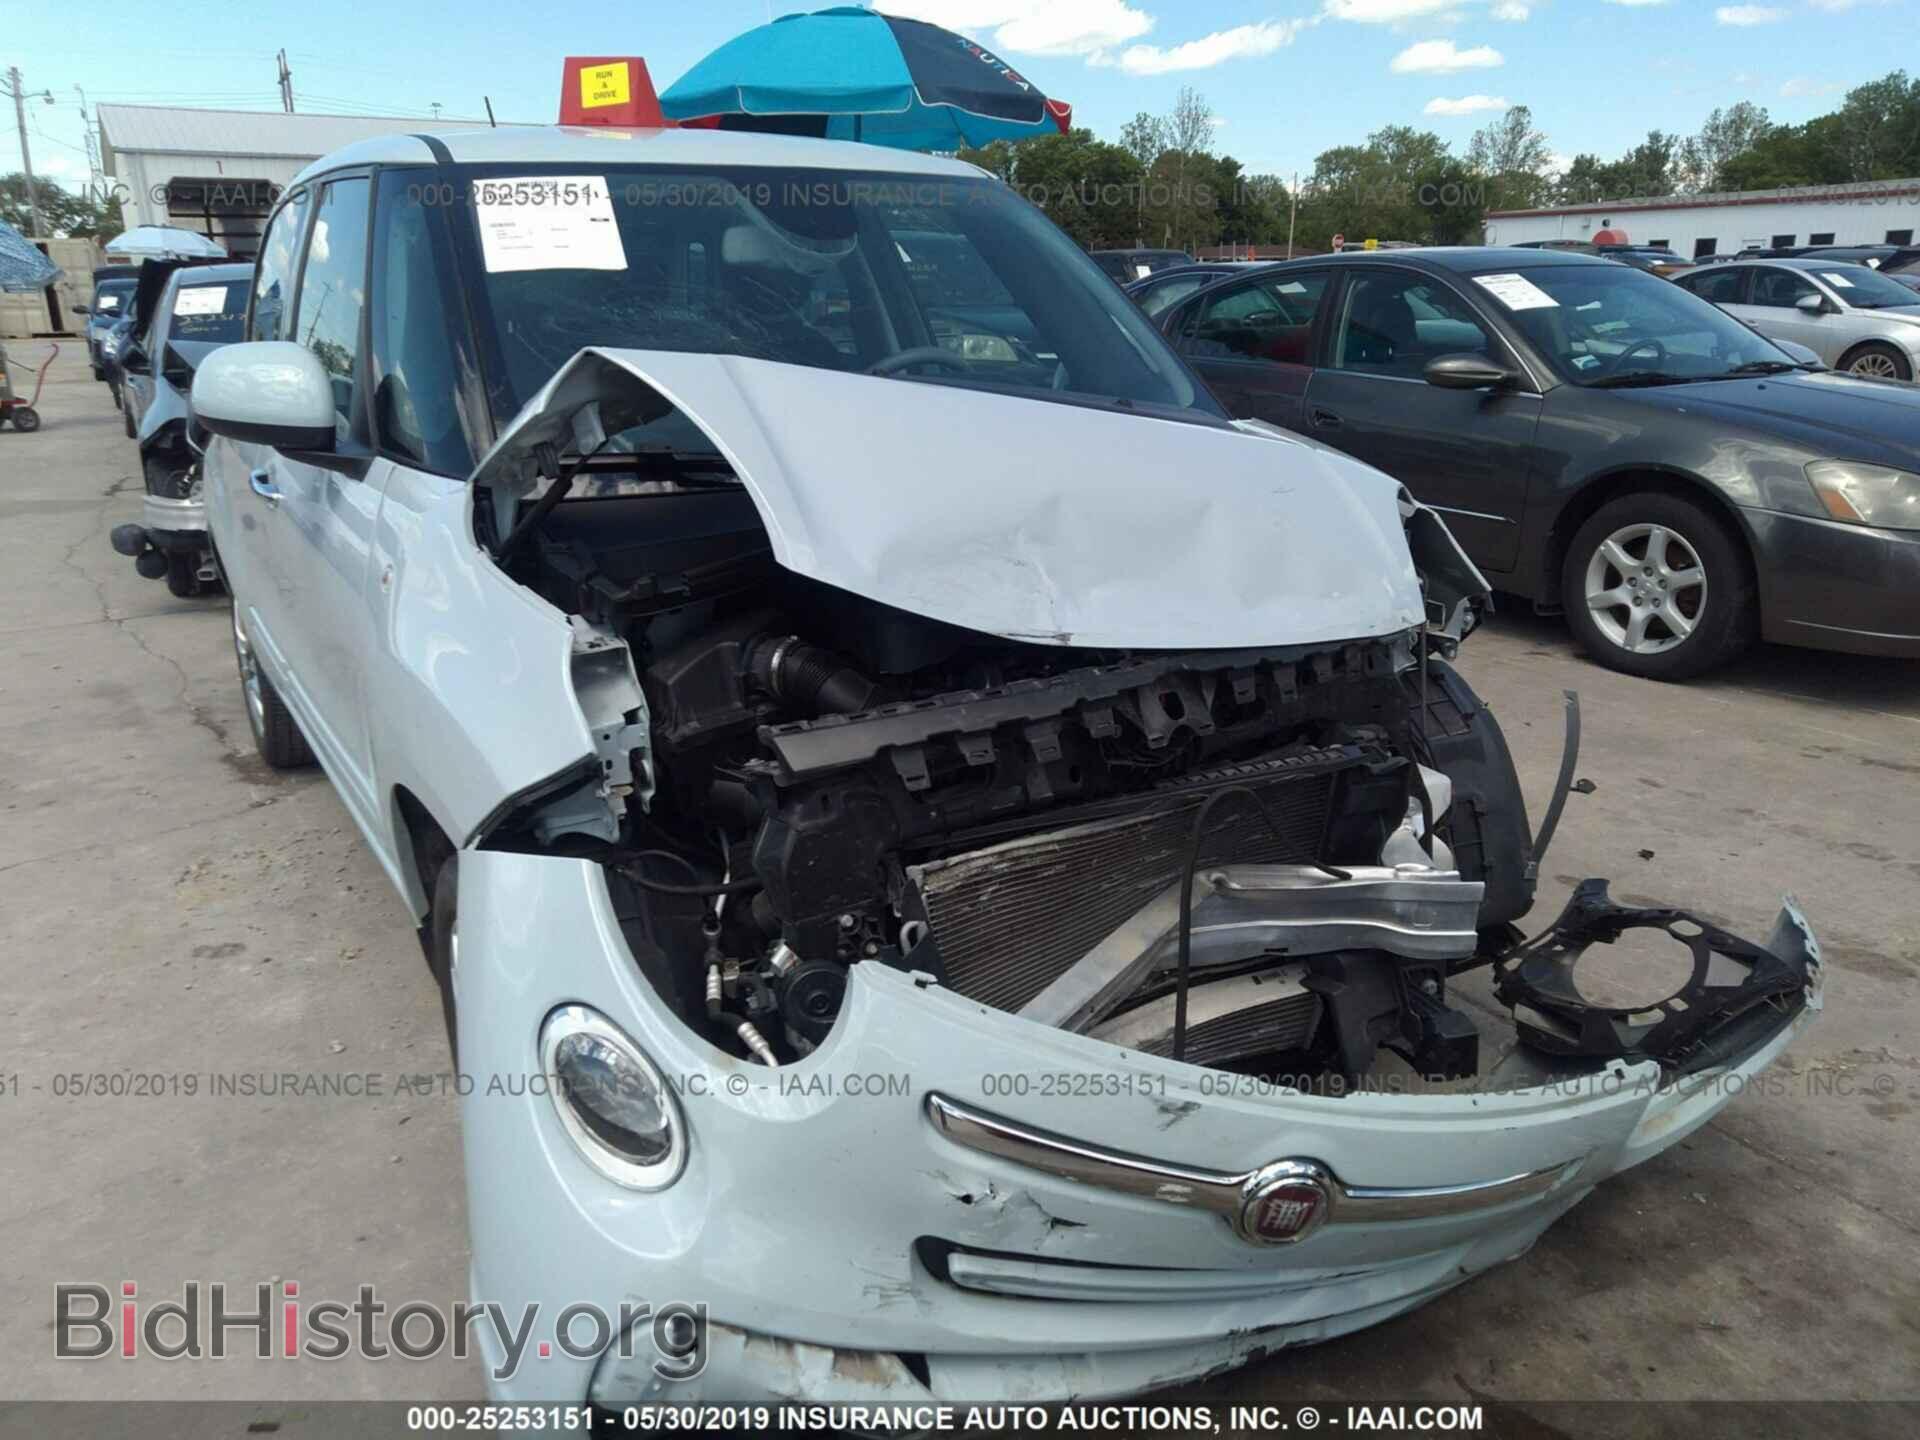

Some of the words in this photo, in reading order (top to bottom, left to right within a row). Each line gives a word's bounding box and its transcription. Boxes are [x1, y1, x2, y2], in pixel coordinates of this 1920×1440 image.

[595, 71, 613, 79] RUN
[957, 39, 1030, 92] NAUTICA
[592, 90, 617, 100] DRIVE
[1262, 1198, 1315, 1231] FIAT
